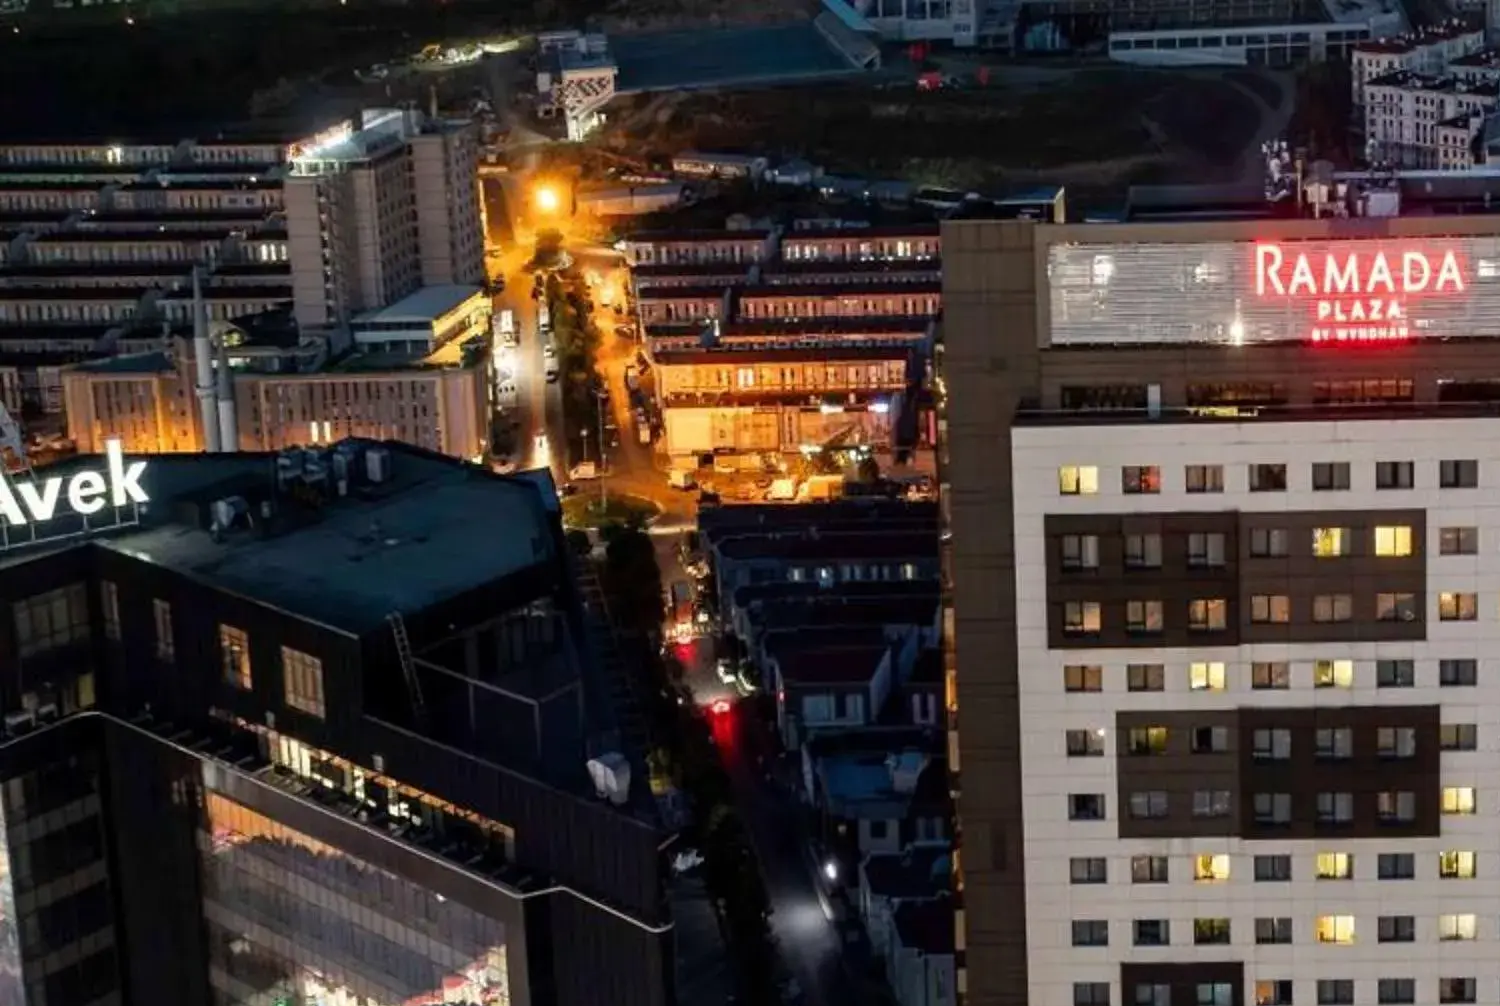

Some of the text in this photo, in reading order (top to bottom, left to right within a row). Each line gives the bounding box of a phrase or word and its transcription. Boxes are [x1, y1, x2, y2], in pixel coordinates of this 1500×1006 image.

[1256, 244, 1464, 295] RAMADA
[1318, 300, 1401, 320] PLAZA
[1311, 327, 1329, 341] BY
